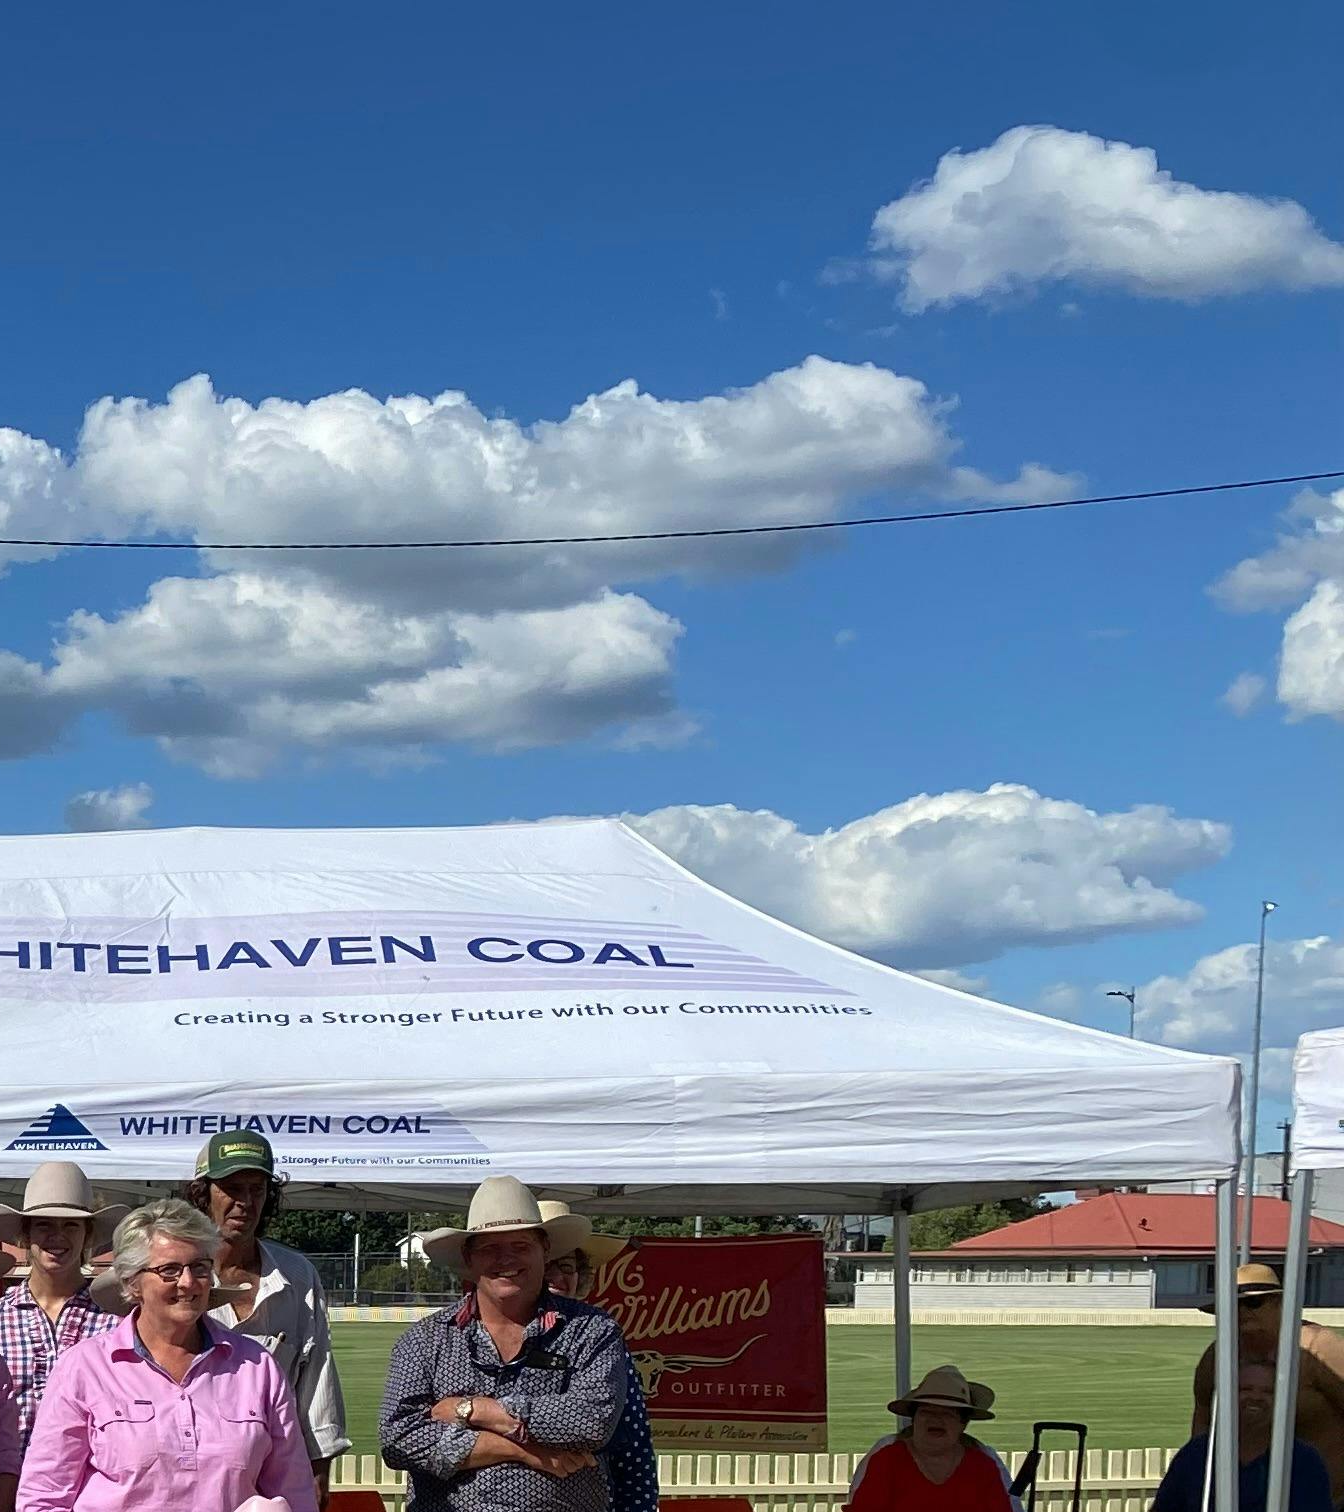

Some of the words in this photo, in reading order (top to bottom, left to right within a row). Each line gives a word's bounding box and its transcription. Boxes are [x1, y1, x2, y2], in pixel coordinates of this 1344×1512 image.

[466, 935, 695, 969] COAL
[174, 1010, 291, 1026] Creating
[299, 1013, 314, 1024] a
[322, 1010, 443, 1027] Stronger
[451, 1007, 544, 1023] Future
[551, 1003, 614, 1020] with
[622, 1003, 670, 1016] our
[678, 1002, 874, 1017] Communities
[119, 1114, 330, 1135] WHITEHAVEN
[342, 1114, 431, 1134] COAL
[13, 1141, 98, 1151] WHITEHAVEN
[281, 1155, 330, 1166] Stronger
[332, 1156, 367, 1165] Future
[370, 1156, 394, 1165] with
[418, 1157, 491, 1166] Communities
[670, 1382, 787, 1398] OUTFITTER
